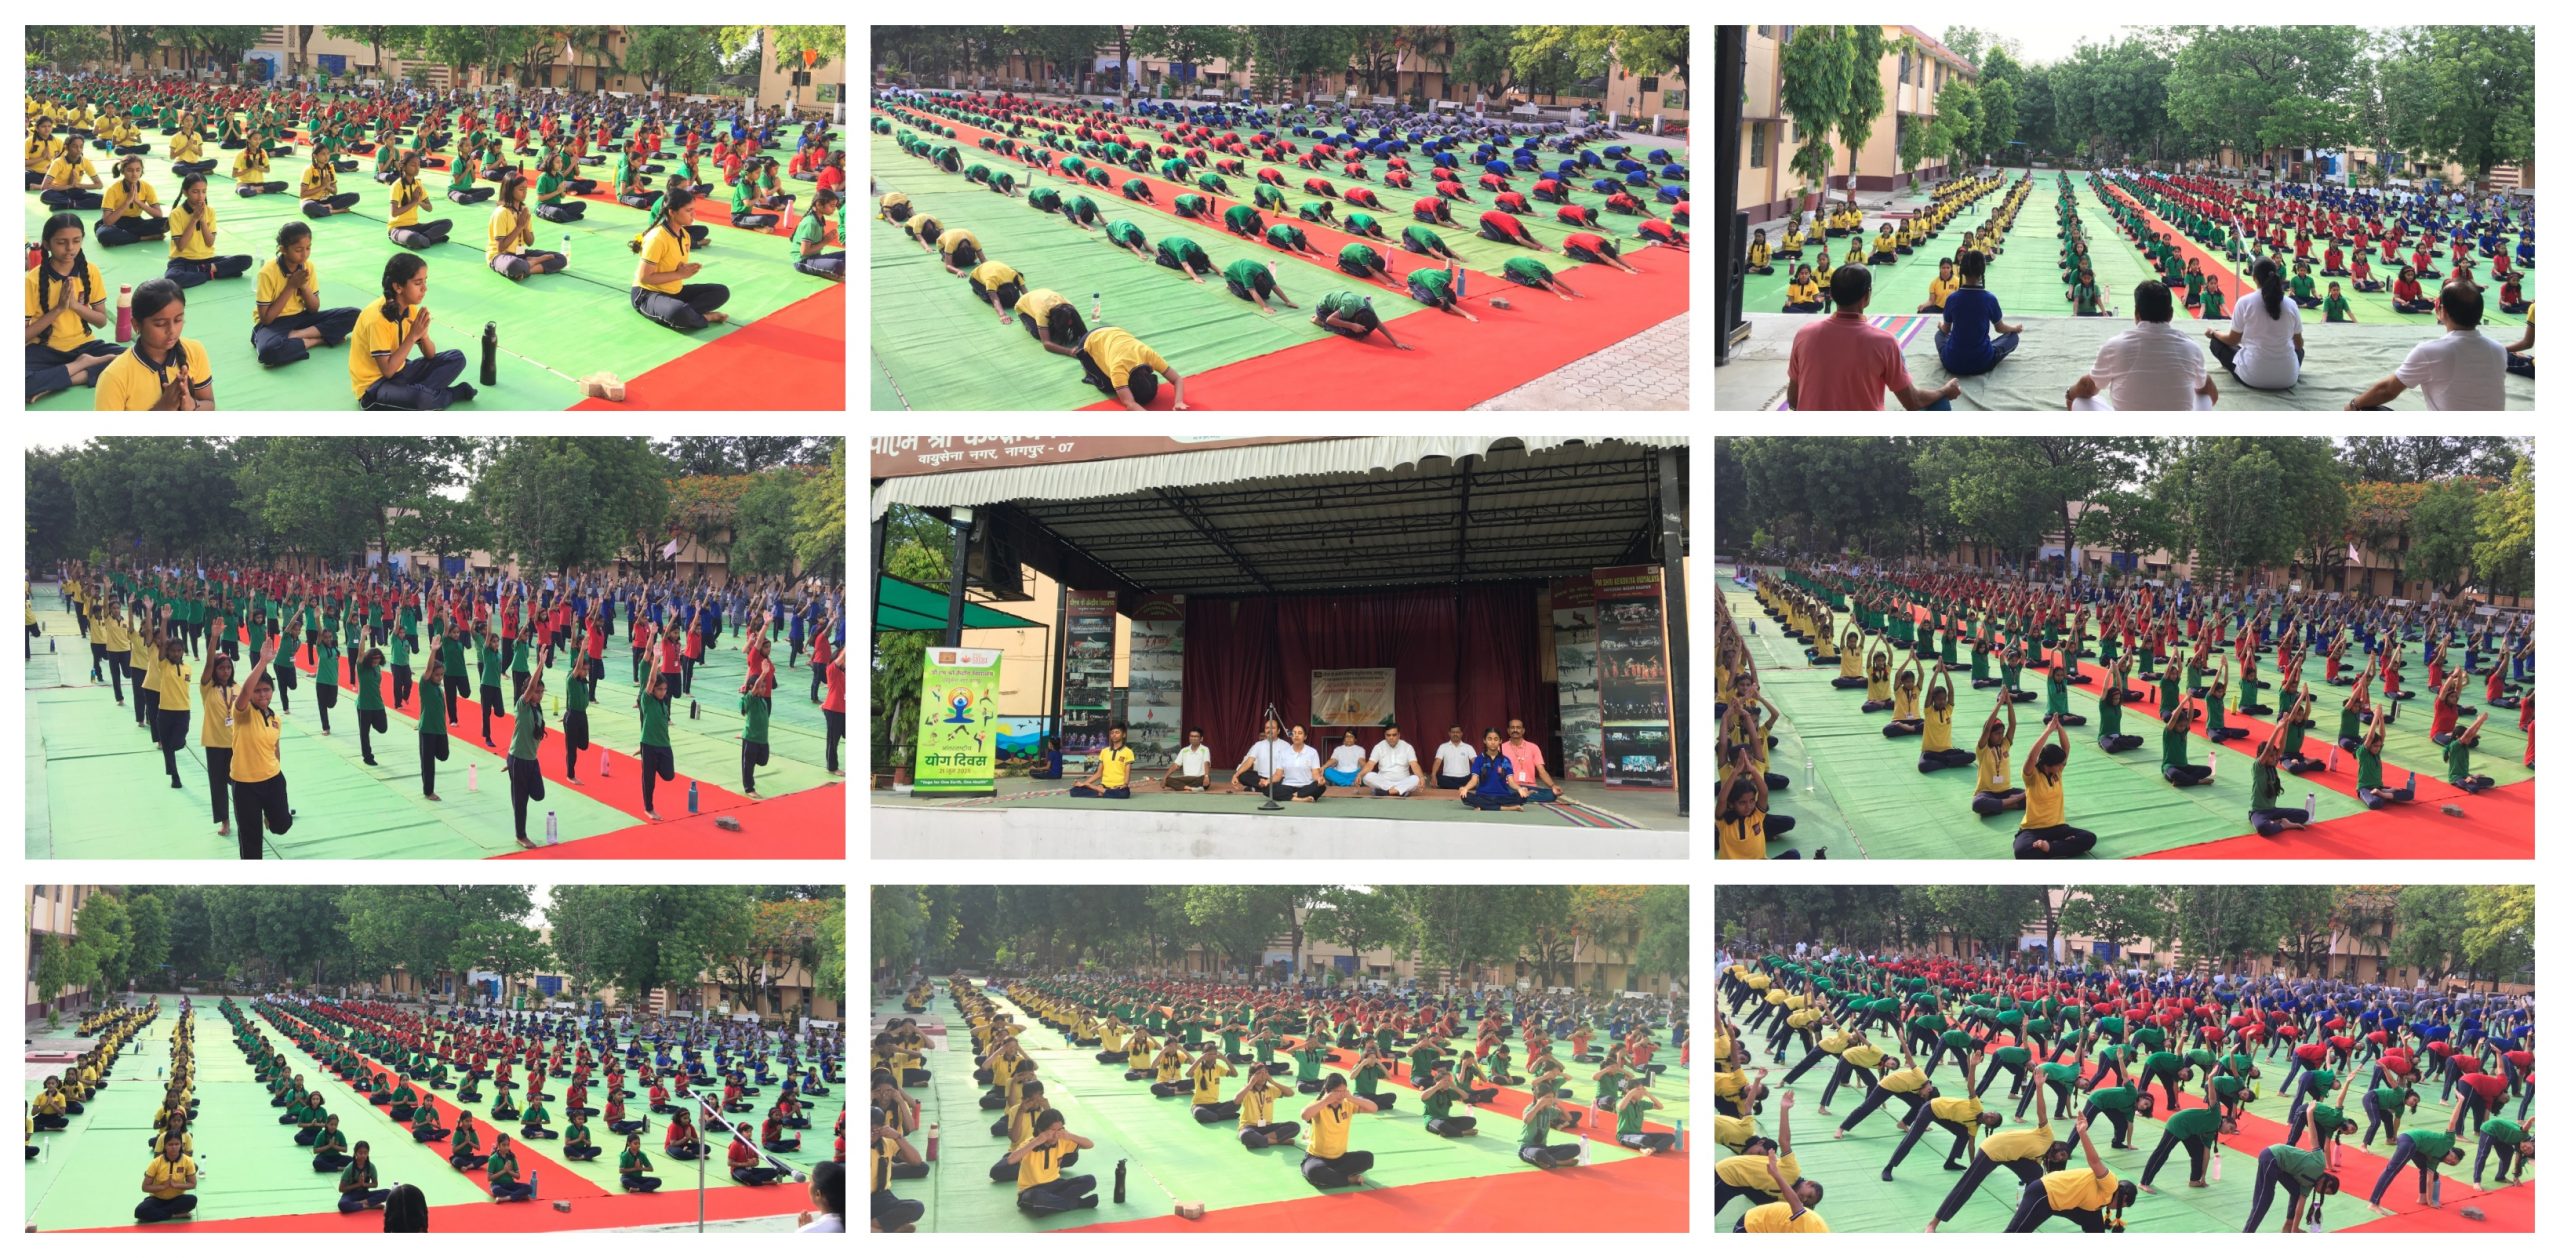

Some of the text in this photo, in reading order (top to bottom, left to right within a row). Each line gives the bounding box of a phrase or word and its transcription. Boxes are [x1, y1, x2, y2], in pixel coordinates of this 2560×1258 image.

[918, 450, 964, 466] वायुसेना
[969, 449, 998, 460] नगर,
[1004, 445, 1045, 459] नागपुर
[1058, 443, 1075, 453] 07
[924, 752, 988, 766] योग दिवस
